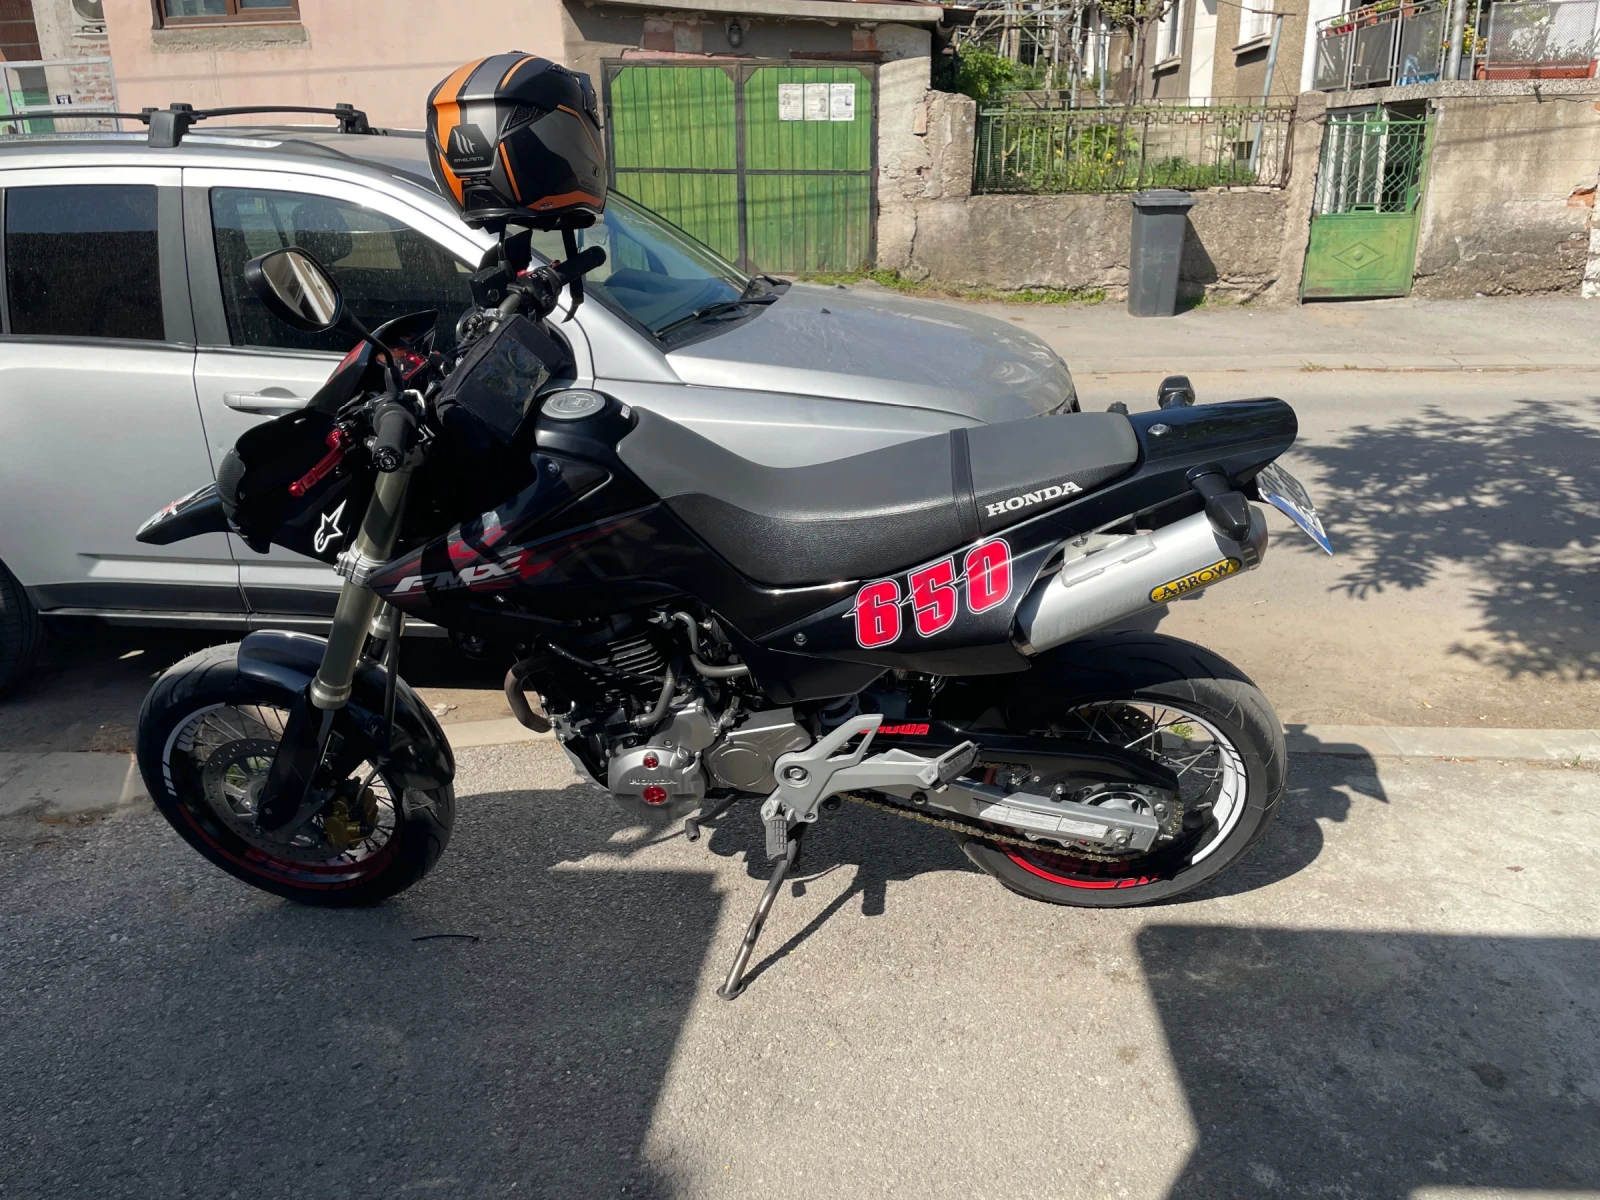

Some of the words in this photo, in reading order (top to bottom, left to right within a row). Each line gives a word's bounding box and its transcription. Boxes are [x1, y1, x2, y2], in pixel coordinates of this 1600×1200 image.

[985, 481, 1083, 517] HONDA
[391, 555, 523, 593] FMX
[1162, 561, 1231, 596] ARROW
[842, 537, 1013, 649] 650
